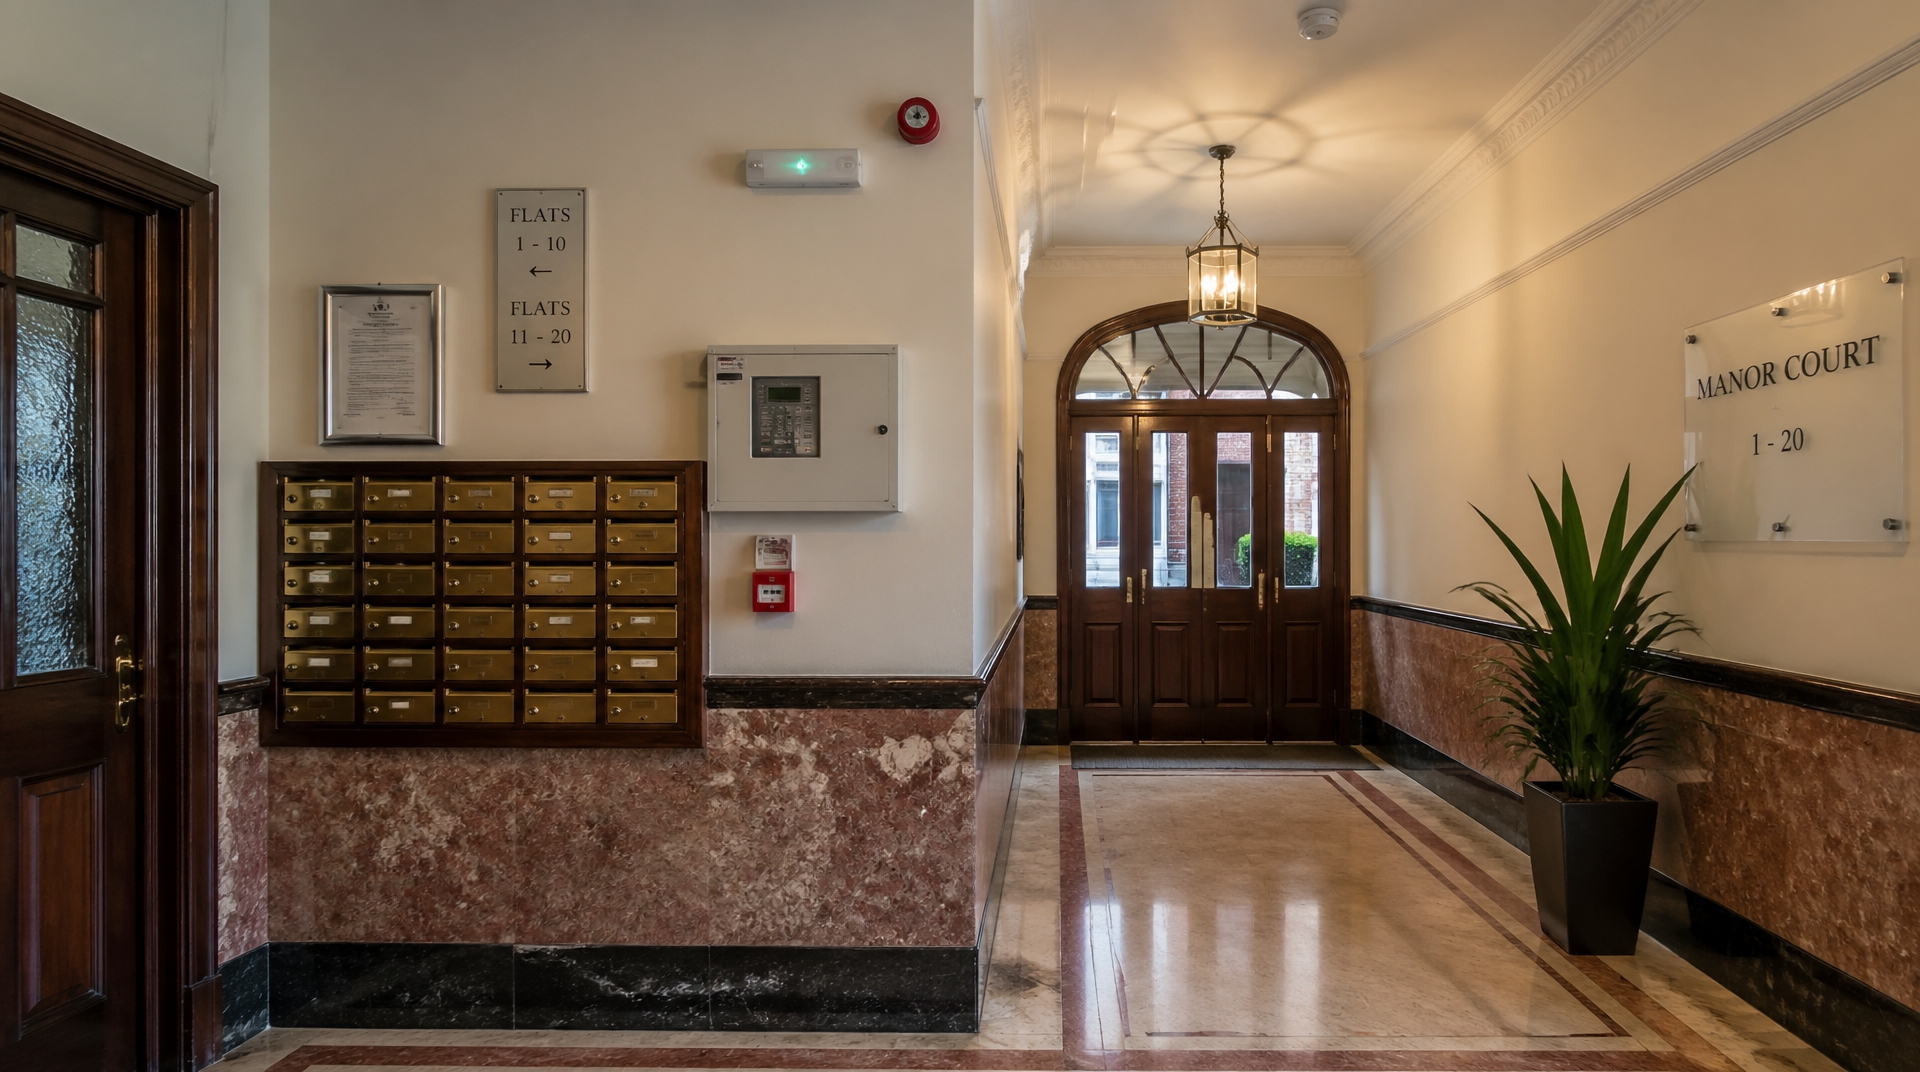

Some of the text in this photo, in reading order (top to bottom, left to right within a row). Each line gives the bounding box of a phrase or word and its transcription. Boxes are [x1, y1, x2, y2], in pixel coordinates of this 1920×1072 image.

[510, 207, 571, 223] FLATS
[517, 236, 524, 252] 1
[547, 236, 566, 252] 10
[510, 300, 571, 316] FLATS
[511, 329, 528, 345] 11
[550, 328, 572, 345] 20
[1696, 334, 1881, 401] MANOR COURT
[1752, 432, 1760, 456] 1
[1780, 427, 1805, 453] 20
